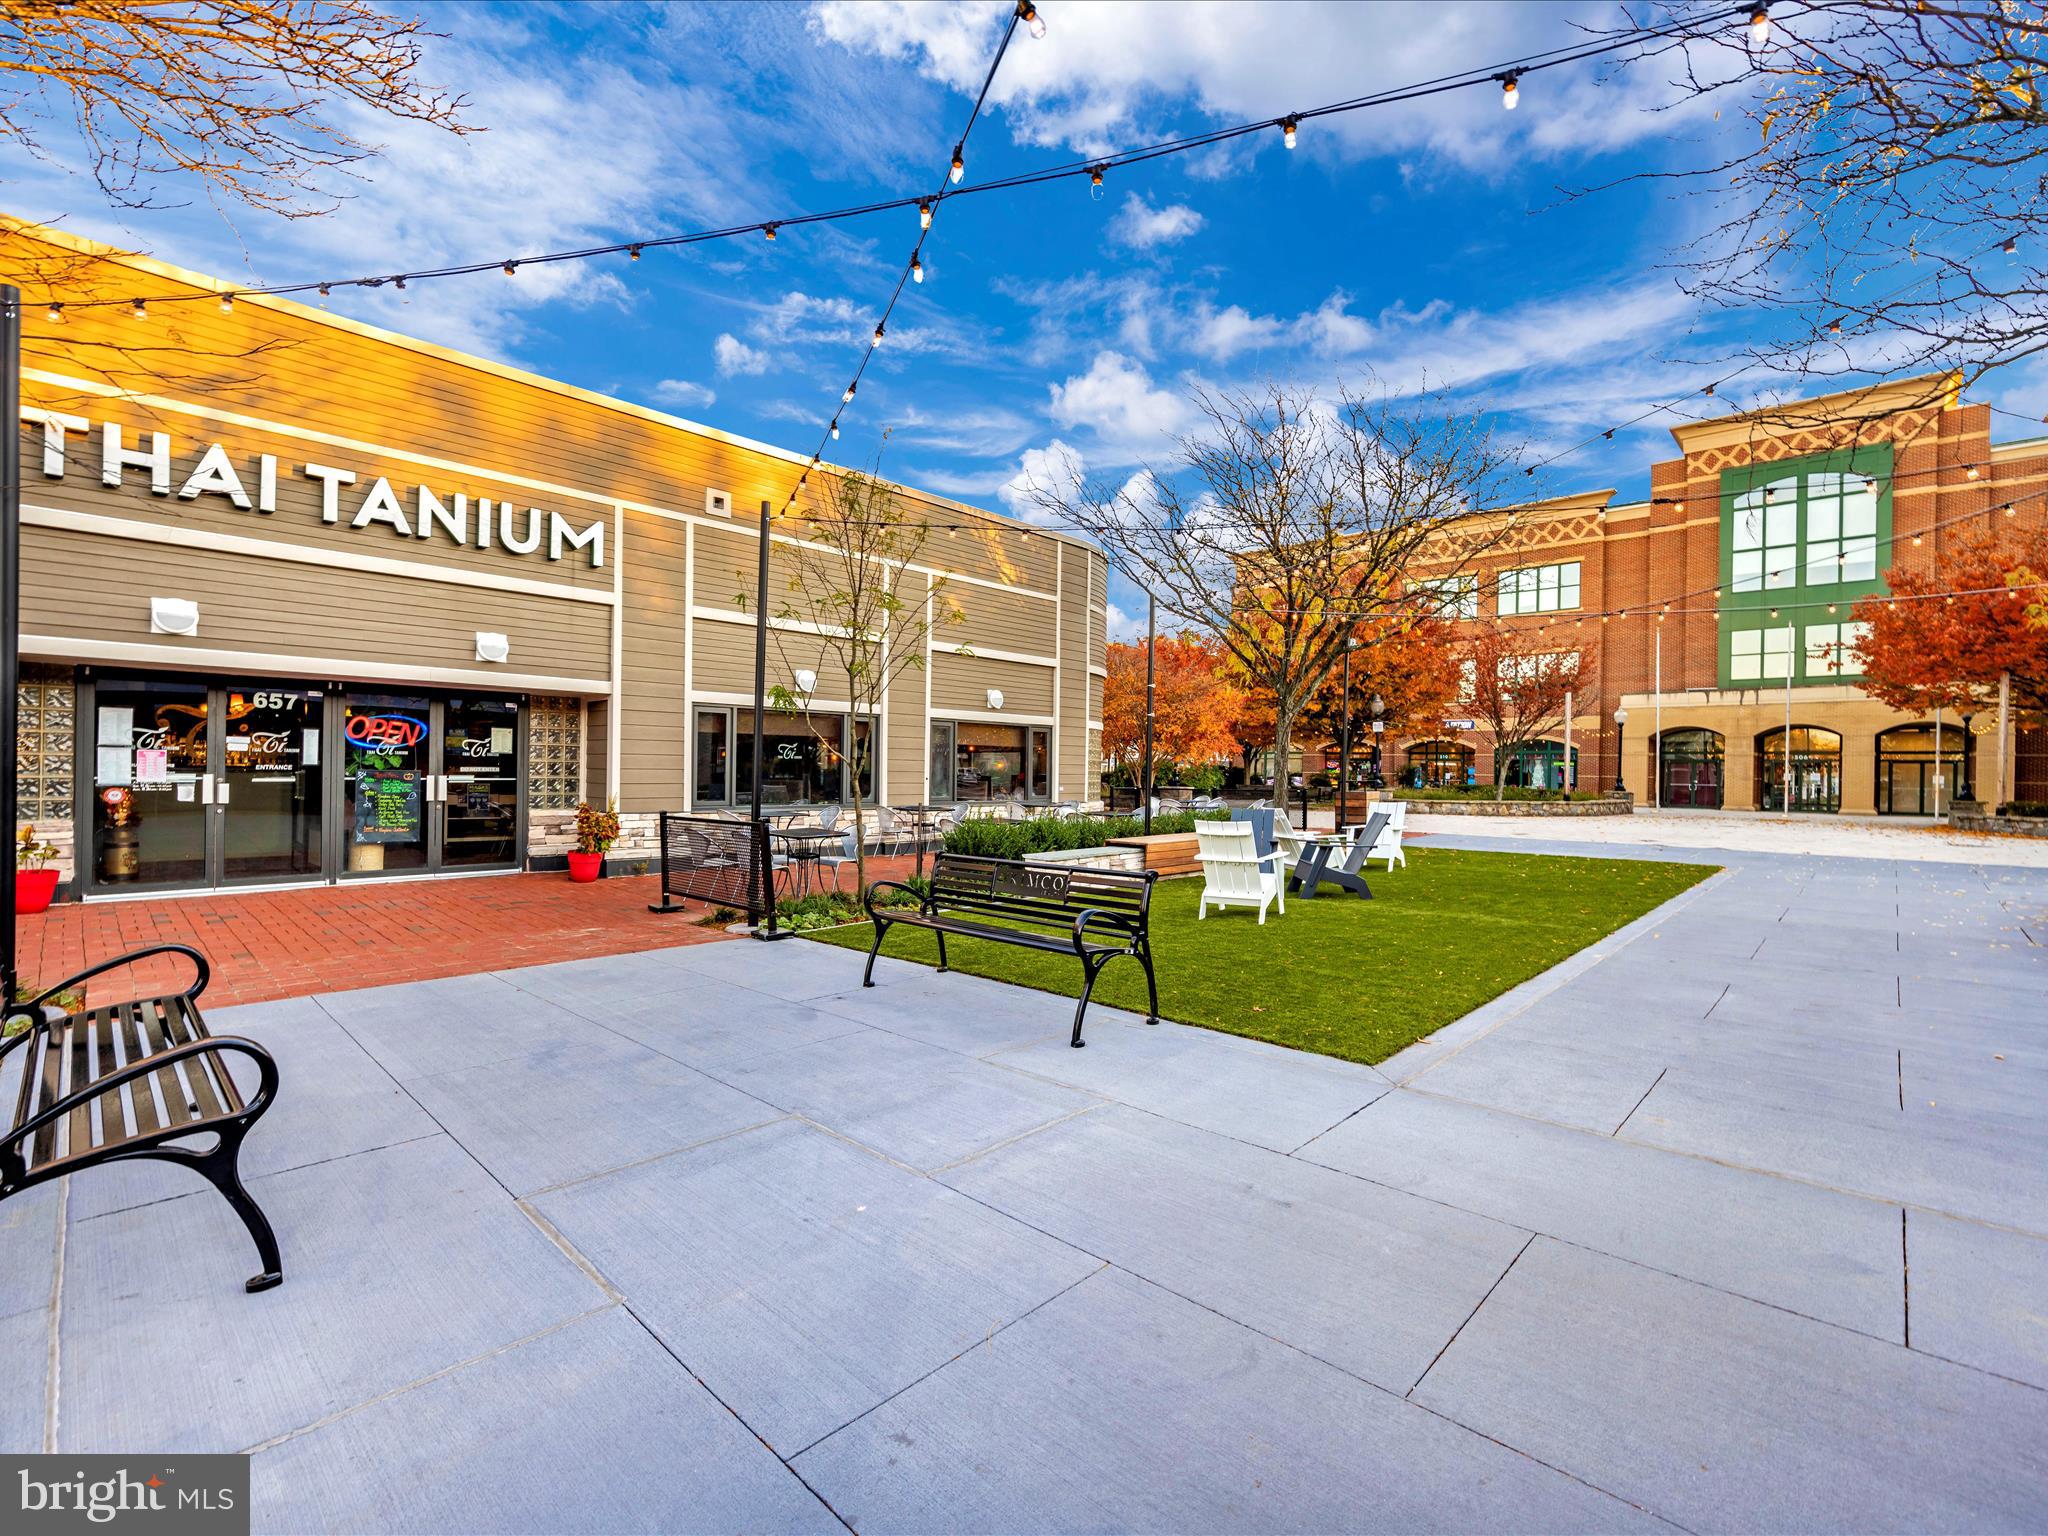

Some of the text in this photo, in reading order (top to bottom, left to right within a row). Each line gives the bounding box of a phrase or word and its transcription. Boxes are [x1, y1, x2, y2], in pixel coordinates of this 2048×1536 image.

[20, 405, 605, 569] THAI TANIUM
[253, 692, 298, 710] 657
[346, 716, 421, 747] OPEN
